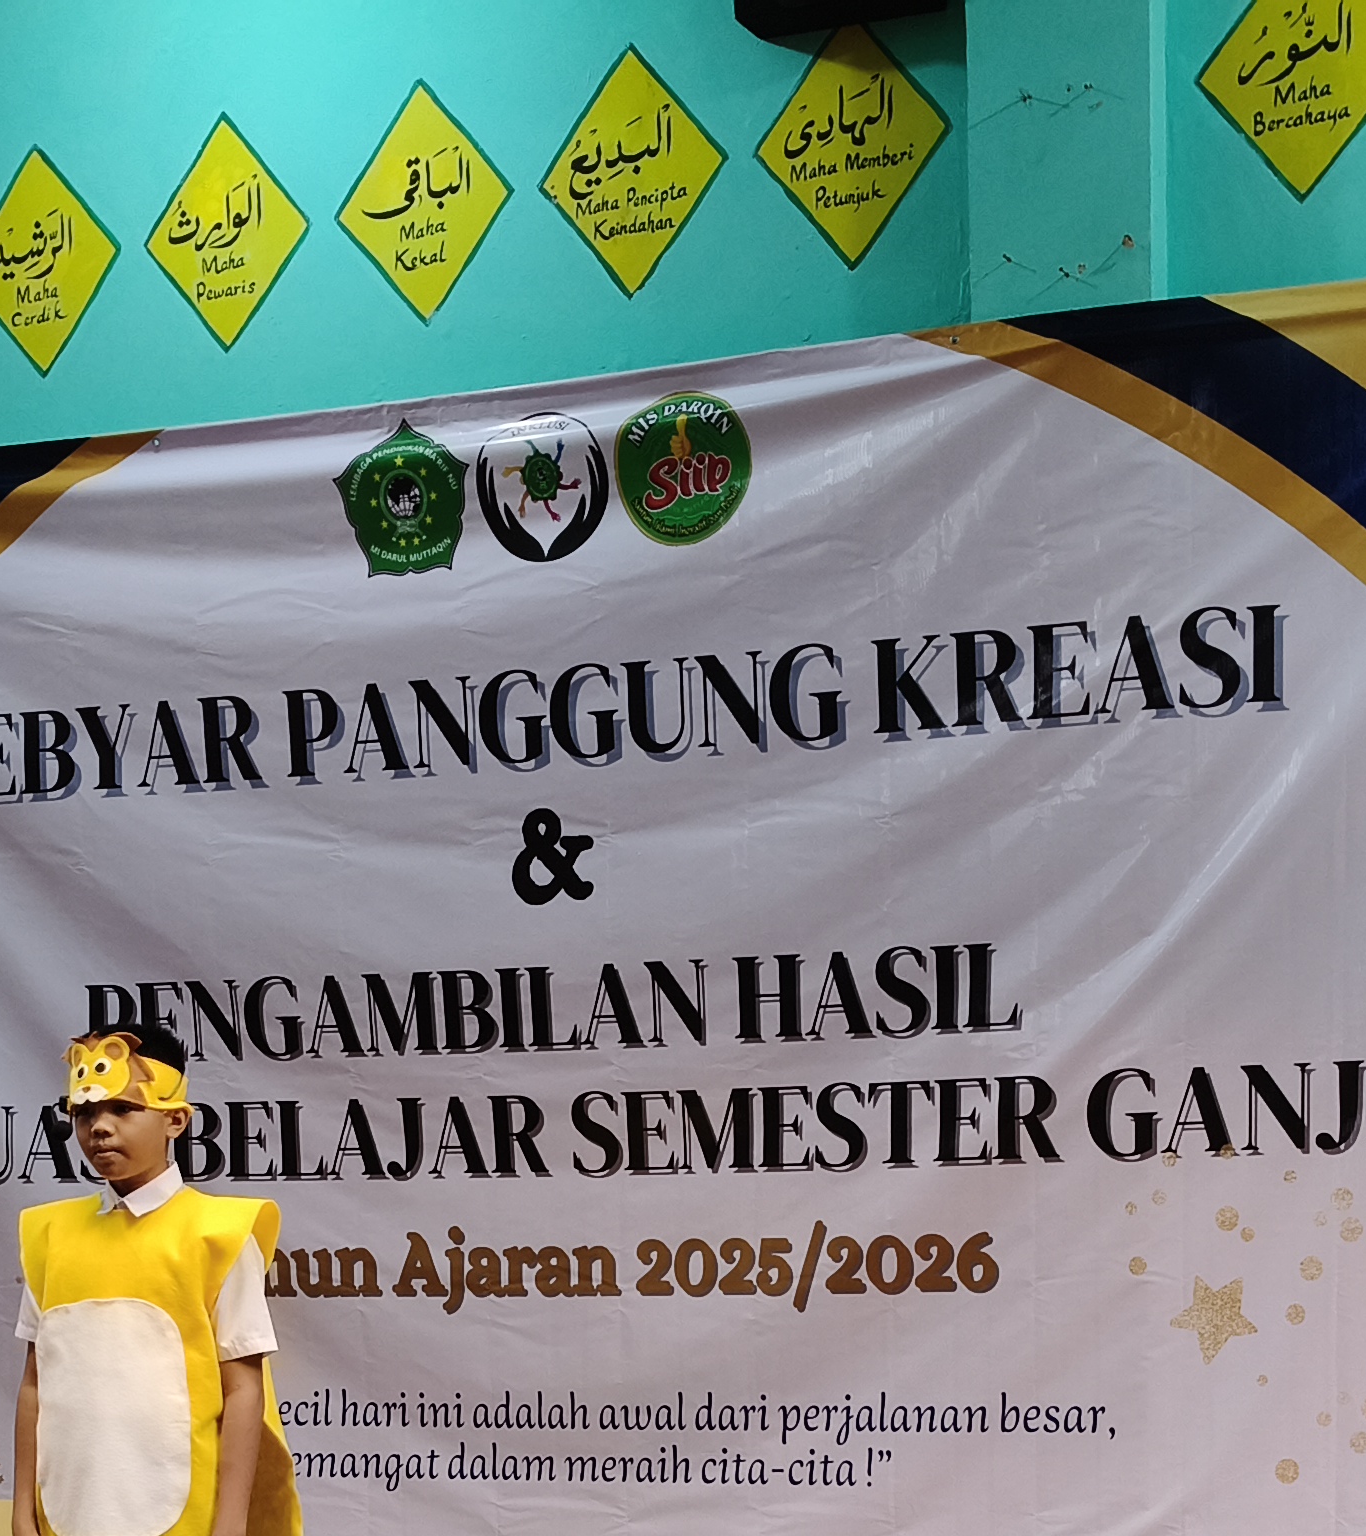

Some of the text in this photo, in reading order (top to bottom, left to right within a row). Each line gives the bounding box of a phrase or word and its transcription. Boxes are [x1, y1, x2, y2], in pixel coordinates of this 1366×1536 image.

[1274, 75, 1332, 108] Maha
[1253, 103, 1351, 137] Bercahaya
[790, 143, 914, 184] Maha Memberi
[576, 181, 688, 220] Maha Pencipta
[815, 180, 888, 213] Petunjuk
[400, 216, 447, 243] Maha
[594, 211, 676, 241] Keindahan
[202, 251, 245, 276] Maha
[395, 240, 447, 272] Kekal
[17, 278, 59, 308] Maha
[196, 279, 256, 304] Pewaris
[12, 300, 68, 327] Cerdik
[511, 420, 571, 437] INKLUSI
[627, 401, 733, 447] MIS DARQIN
[350, 457, 373, 501] LEMBAGA
[372, 444, 425, 460] PENDIDIKAN
[446, 473, 459, 490] NU
[370, 536, 451, 563] MI DARUL MUTTAQIN
[281, 642, 846, 784] PANGGUNG
[871, 604, 1291, 742] KREASI
[512, 808, 594, 905] &
[732, 943, 1023, 1046] HASIL
[174, 1093, 552, 1184] BELAJAR
[571, 1074, 1064, 1178] SEMESTER
[392, 1225, 622, 1315] Ajaran
[635, 1219, 999, 1312] 2025/2026
[278, 1388, 1117, 1446] ecil hari ini adalah awal dari perjalanan besar,
[292, 1441, 857, 1492] emangat dalam meraih cita-cita
